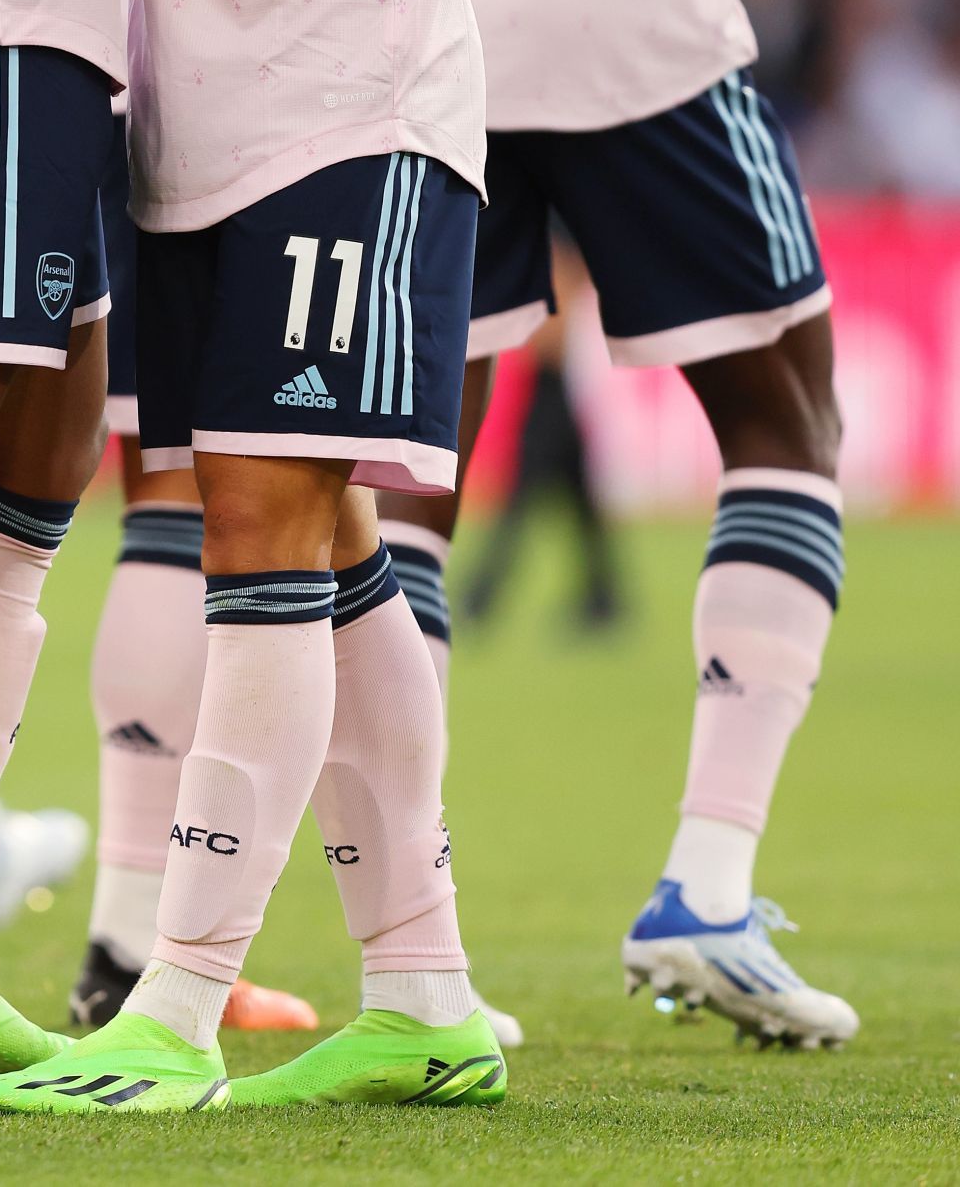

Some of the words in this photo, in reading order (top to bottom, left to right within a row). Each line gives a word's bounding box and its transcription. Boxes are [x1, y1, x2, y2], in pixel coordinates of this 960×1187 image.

[43, 263, 70, 277] Arsenal
[283, 235, 364, 354] 11
[273, 389, 337, 410] adidas
[170, 823, 240, 855] AFC
